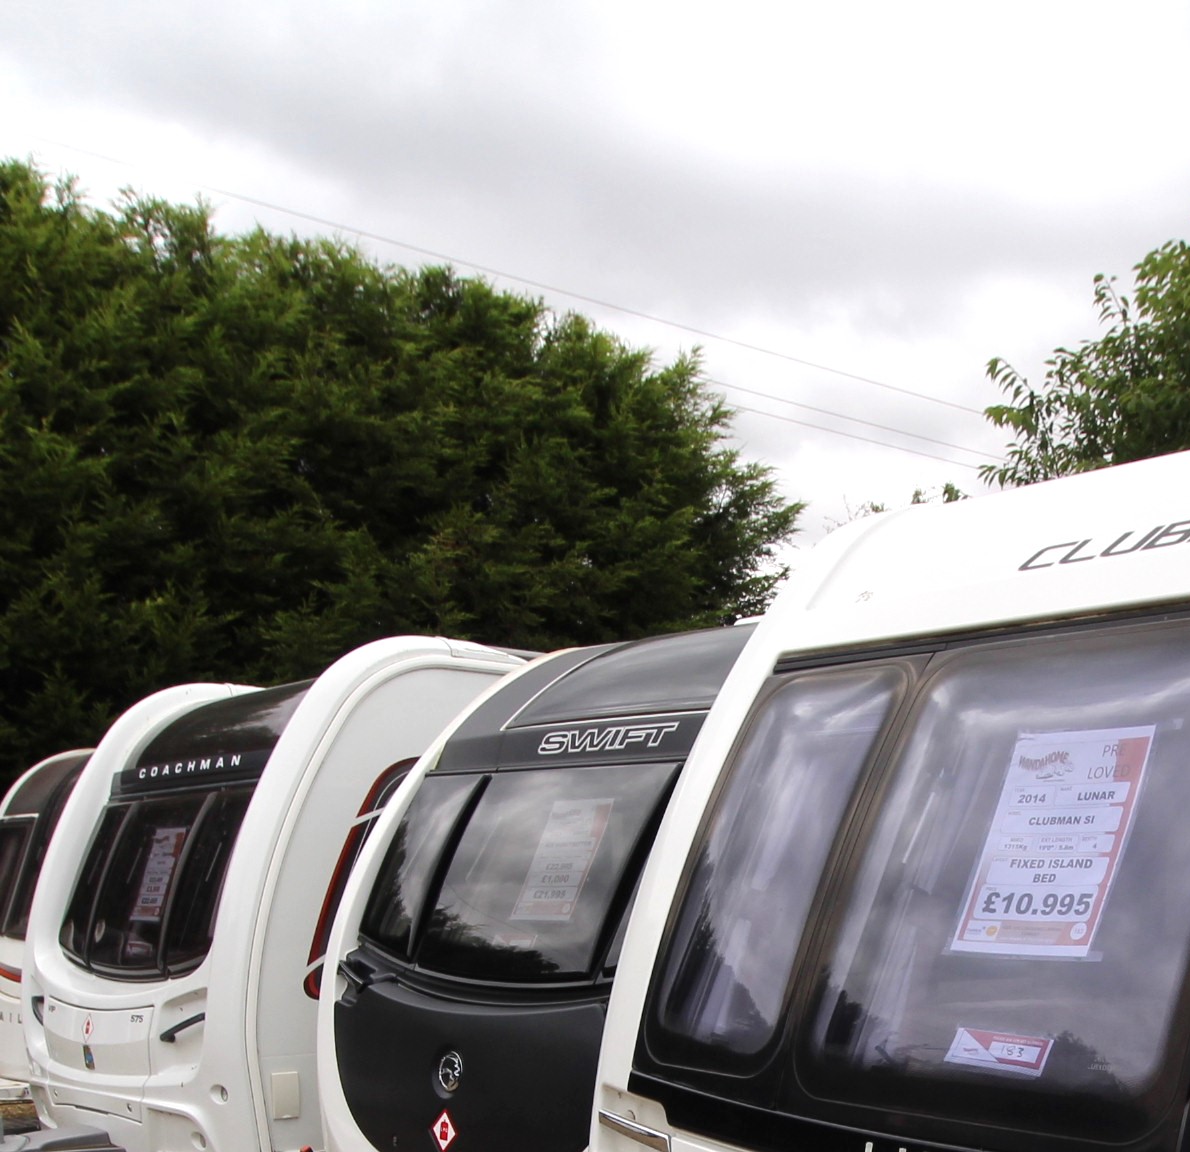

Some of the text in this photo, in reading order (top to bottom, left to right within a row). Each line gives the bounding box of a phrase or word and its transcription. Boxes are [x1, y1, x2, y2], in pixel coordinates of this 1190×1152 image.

[538, 721, 680, 754] SWIFT
[1102, 744, 1125, 757] PRE
[139, 755, 241, 779] COACHMAN
[1087, 764, 1131, 780] LOVED
[1017, 793, 1046, 804] 2014
[1077, 790, 1115, 801] LUNAR
[1028, 815, 1095, 826] CLUBMAN SI
[1009, 859, 1045, 868] FIXED
[1048, 859, 1093, 869] ISLAND
[1032, 873, 1057, 883] BED
[982, 892, 1094, 916] £10.995
[131, 1014, 143, 1023] 575
